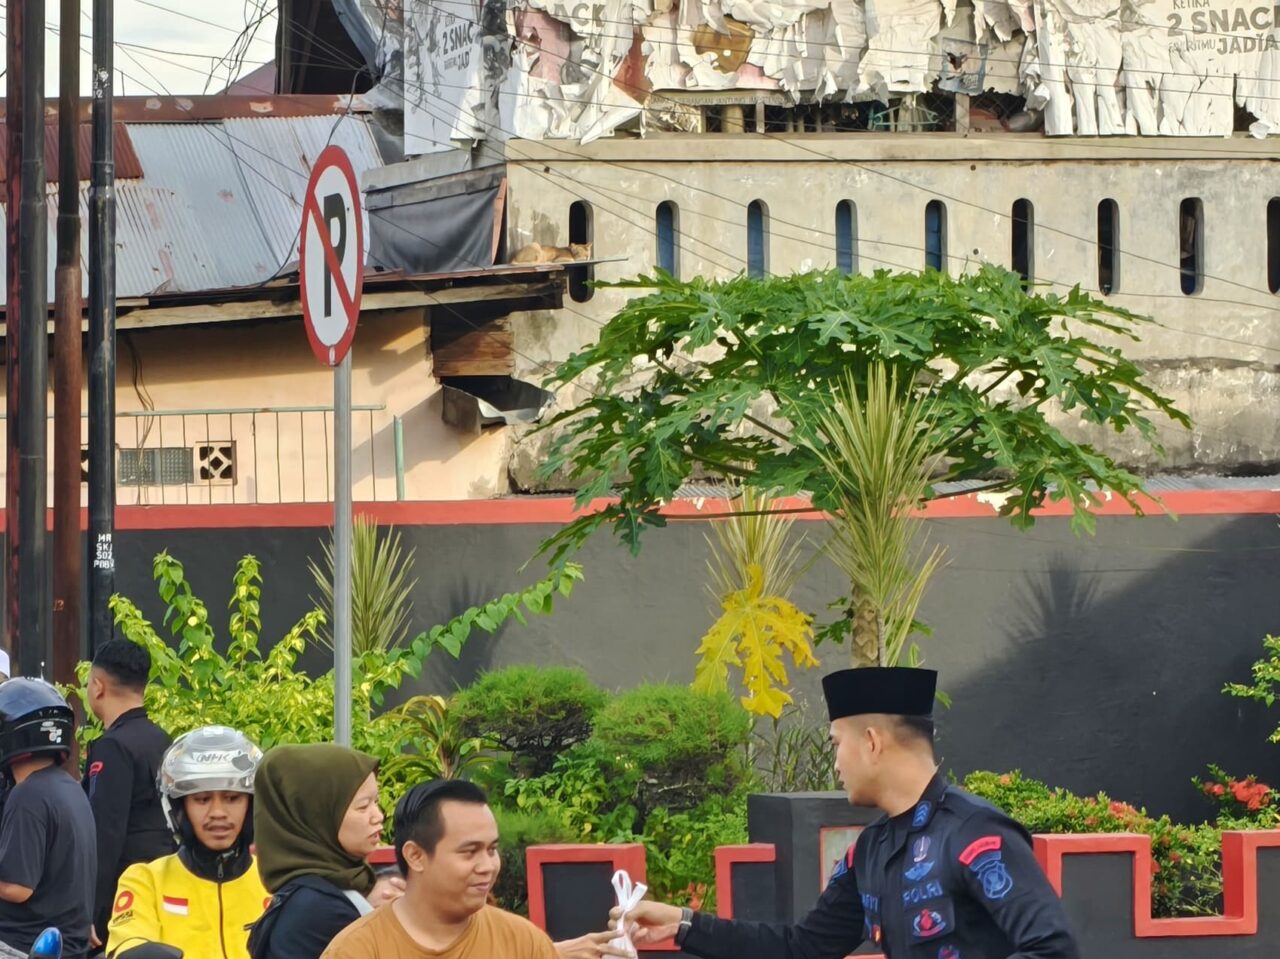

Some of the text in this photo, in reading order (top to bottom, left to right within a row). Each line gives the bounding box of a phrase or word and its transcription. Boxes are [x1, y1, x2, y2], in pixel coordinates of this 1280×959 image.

[1167, 13, 1183, 37] 2
[443, 22, 473, 55] 2 SNAC
[902, 882, 943, 906] POLRI
